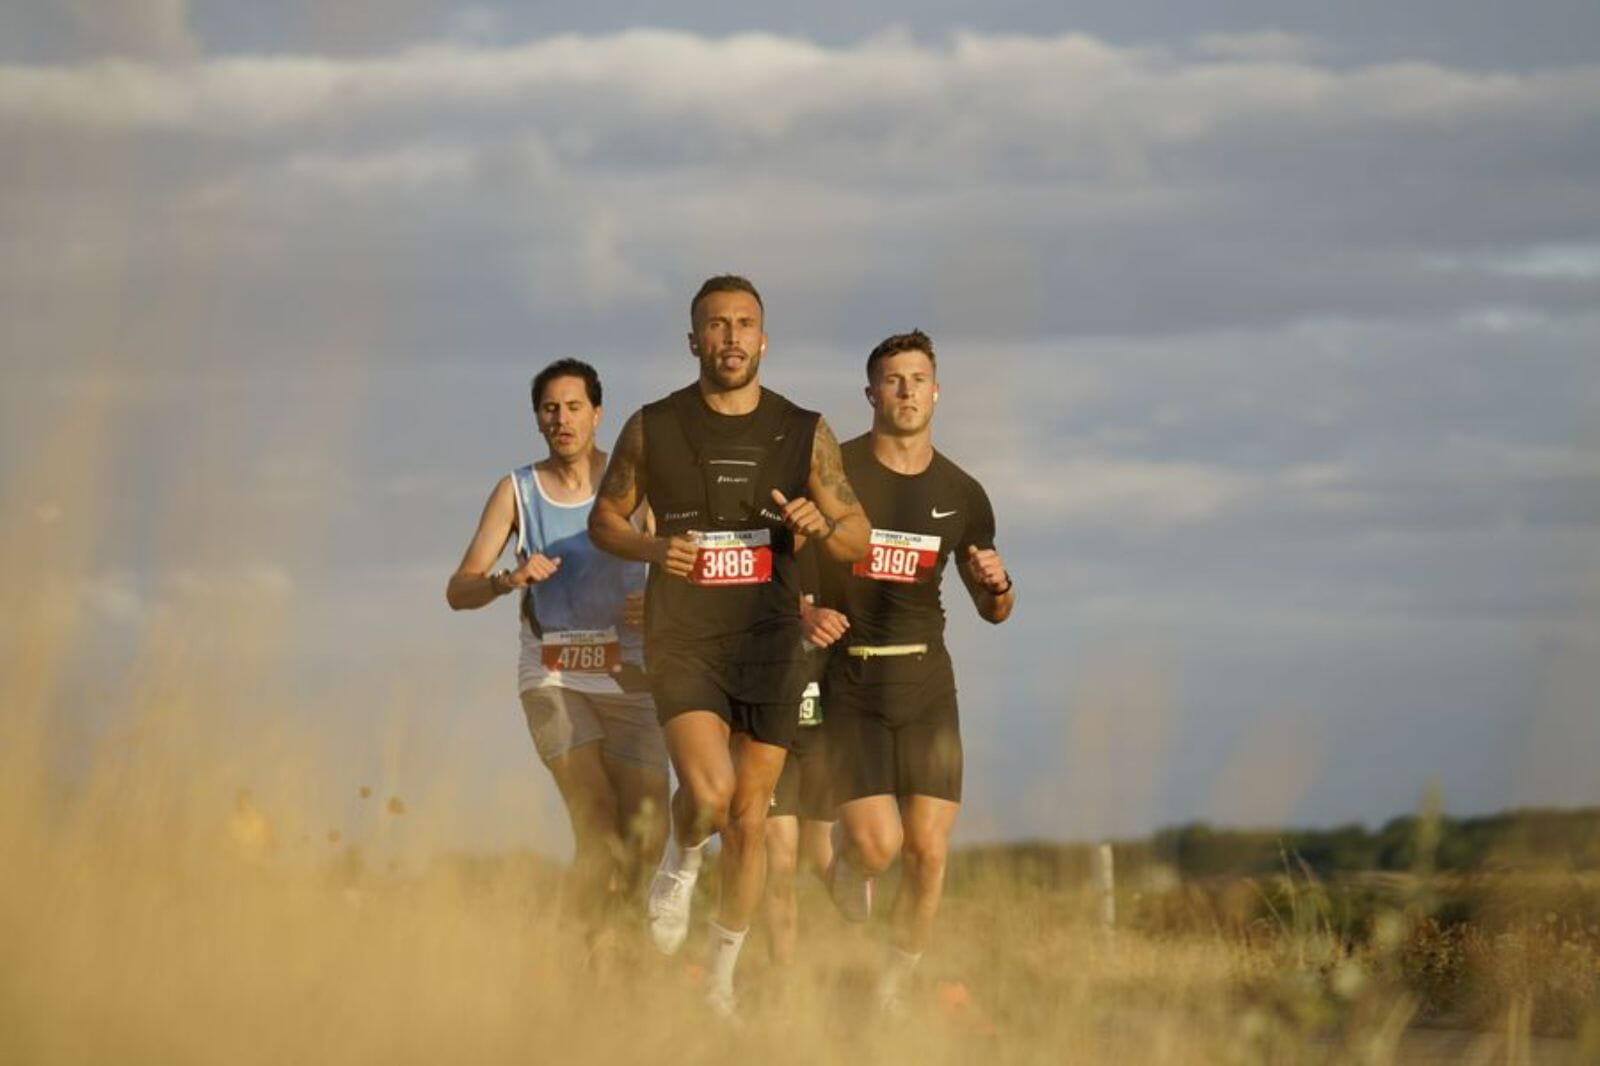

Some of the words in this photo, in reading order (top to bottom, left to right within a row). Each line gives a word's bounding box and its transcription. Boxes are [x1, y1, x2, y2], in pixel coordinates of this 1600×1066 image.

[703, 550, 753, 578] 3186
[871, 546, 919, 576] 3190
[559, 645, 605, 669] 4768
